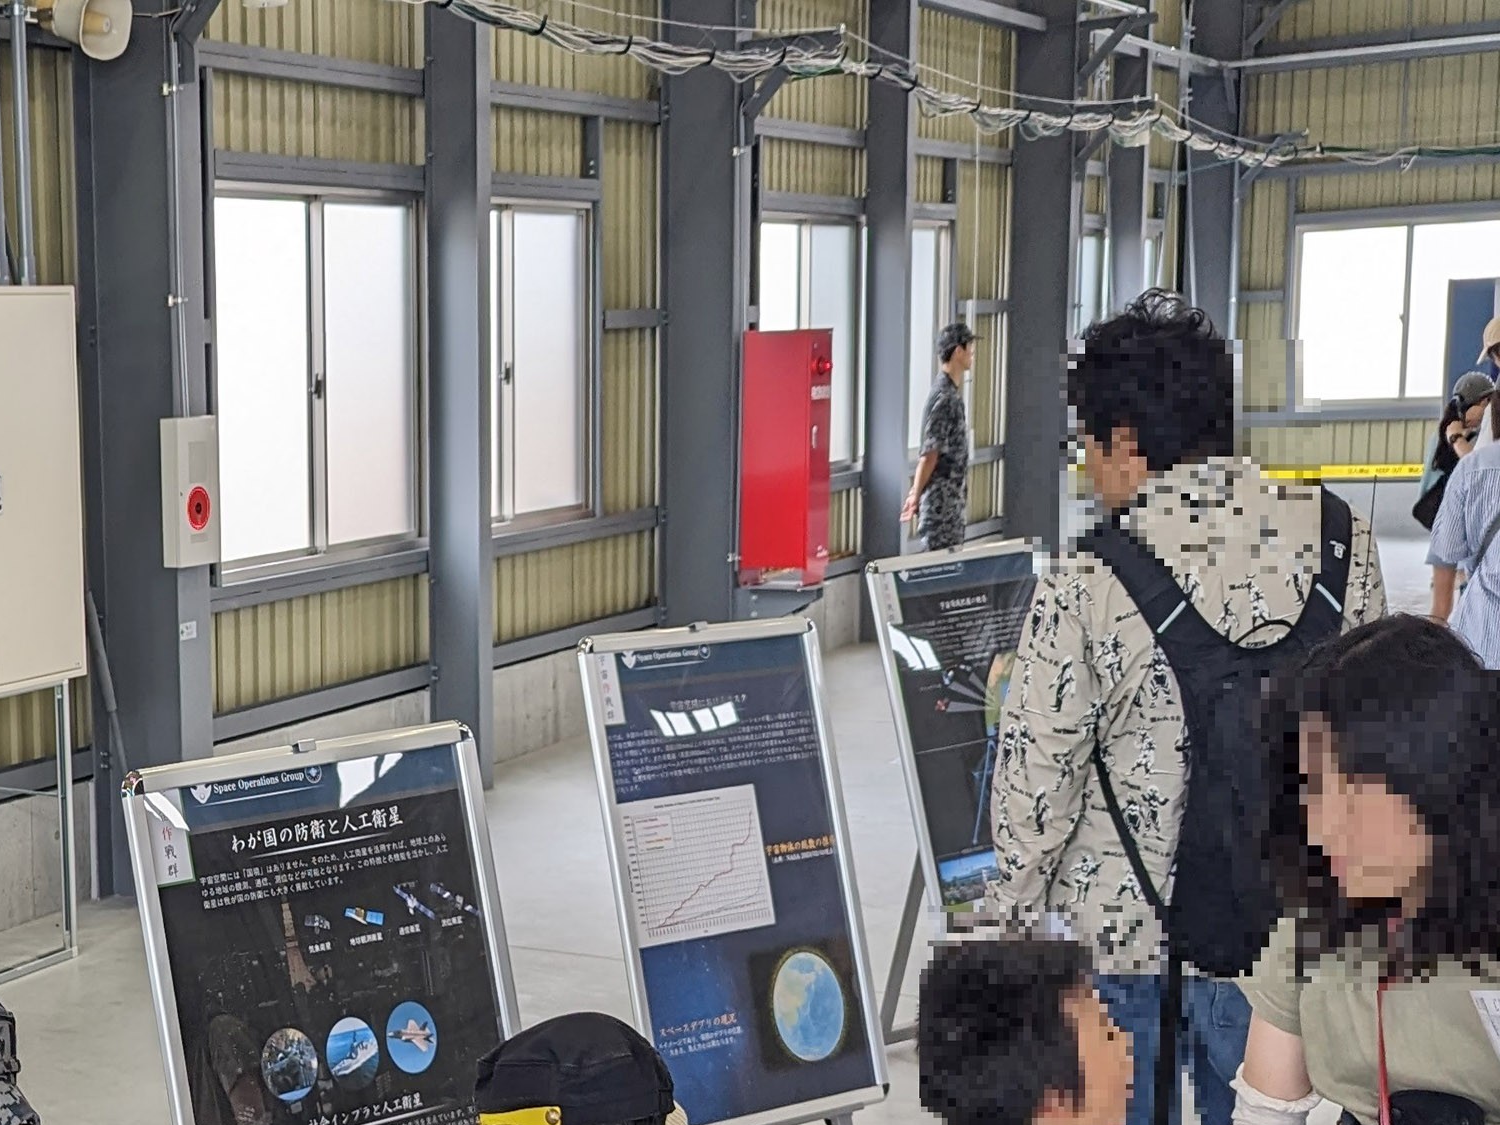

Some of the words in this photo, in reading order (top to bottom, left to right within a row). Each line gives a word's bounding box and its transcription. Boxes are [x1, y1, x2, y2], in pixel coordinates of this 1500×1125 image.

[213, 783, 236, 795] Space
[237, 775, 279, 790] Operations
[281, 769, 304, 783] Group
[161, 816, 179, 878] 作戦群
[231, 805, 403, 853] わが国の防衛と人工衛星
